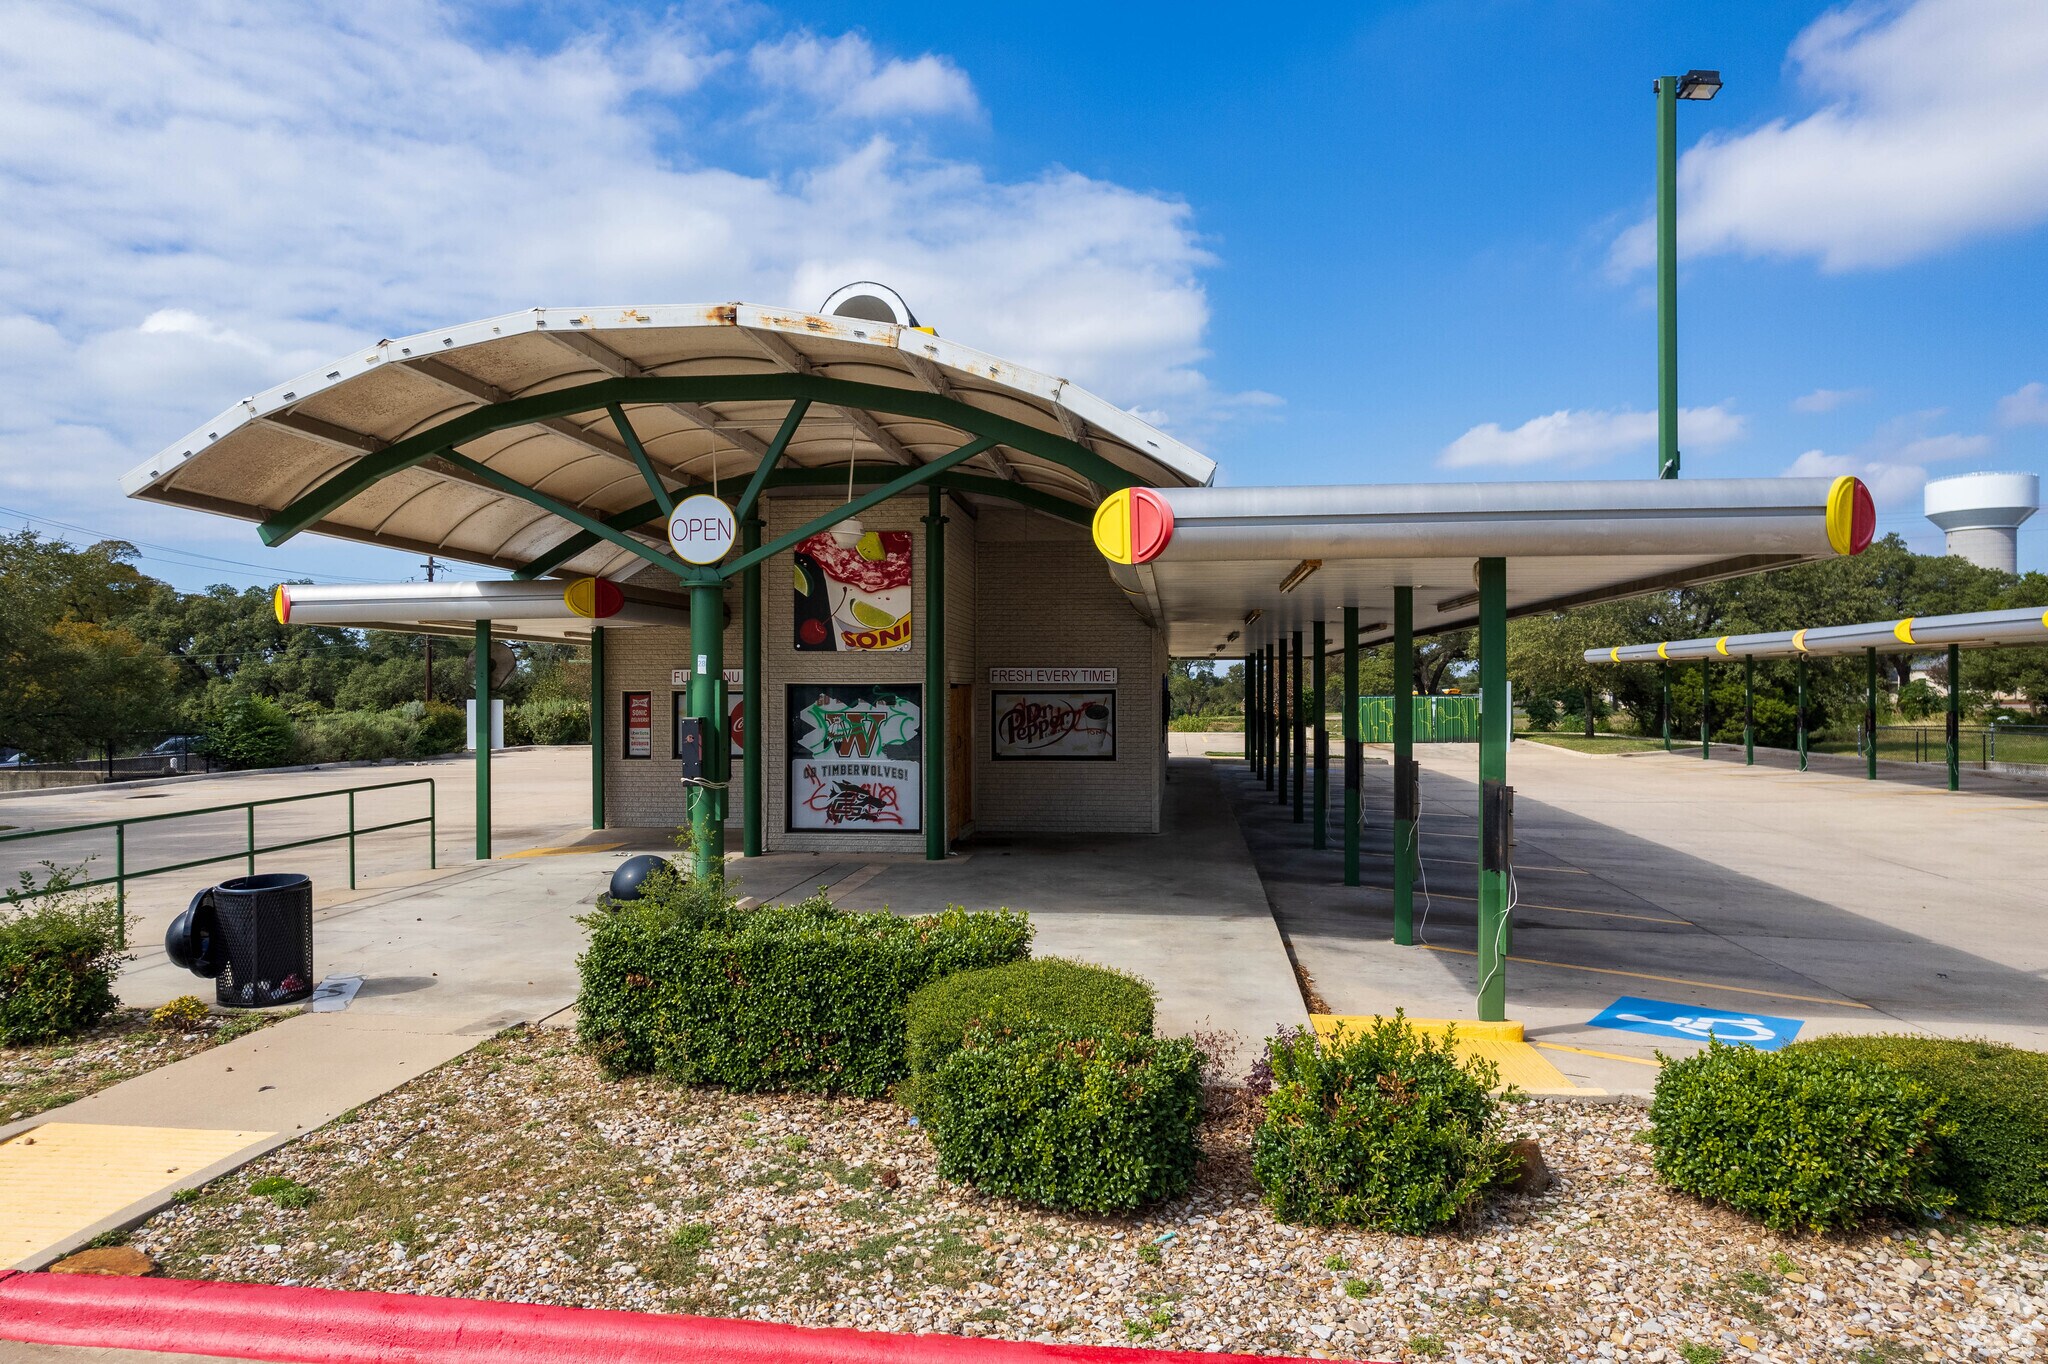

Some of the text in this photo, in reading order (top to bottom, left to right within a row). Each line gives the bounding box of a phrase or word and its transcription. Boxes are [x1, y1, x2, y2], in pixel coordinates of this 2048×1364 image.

[671, 517, 732, 541] OPEN
[842, 620, 910, 649] SONI
[674, 671, 740, 683] FU NU
[991, 669, 1116, 682] FRESH EVERY TIME!
[1026, 703, 1053, 720] Dr
[1007, 709, 1070, 745] Pepper
[821, 763, 909, 781] TIMBERWOLVES!
